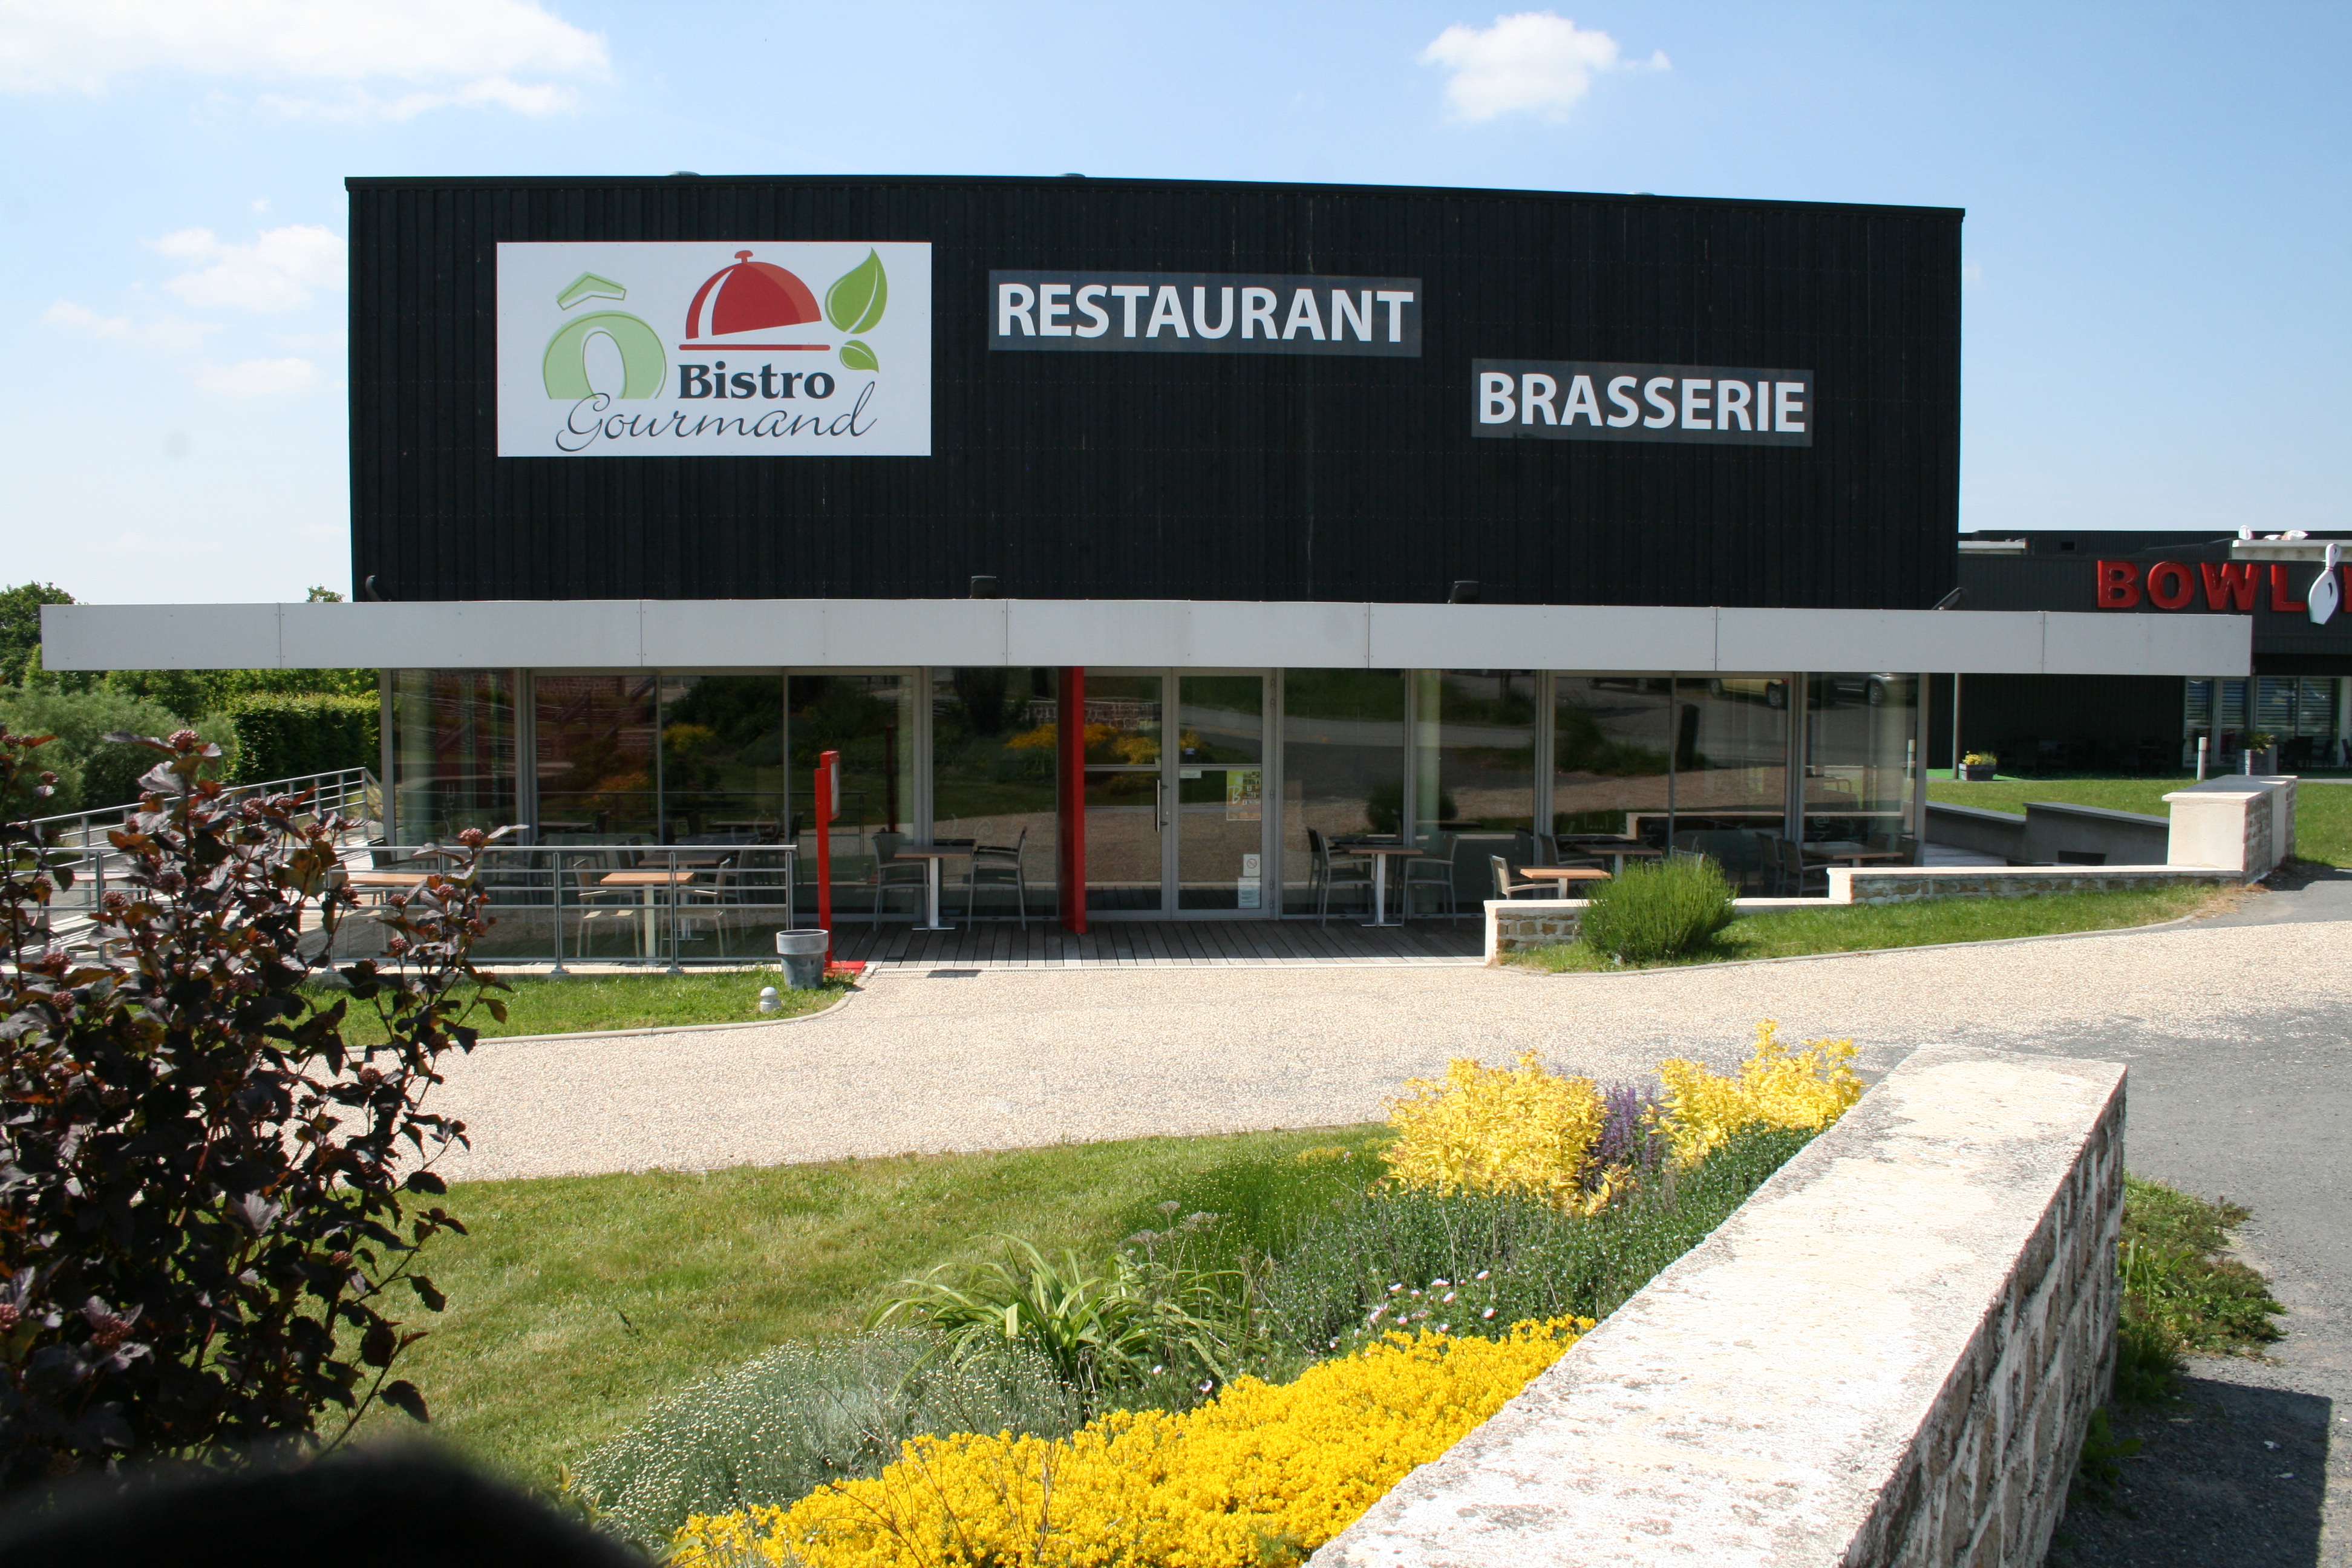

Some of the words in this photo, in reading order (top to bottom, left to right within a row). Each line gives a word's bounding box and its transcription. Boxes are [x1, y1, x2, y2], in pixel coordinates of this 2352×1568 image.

[998, 283, 1414, 342] RESTAURANT
[678, 361, 835, 399] Bistro
[1479, 371, 1805, 433] BRASSERIE
[555, 381, 878, 452] Gourmand
